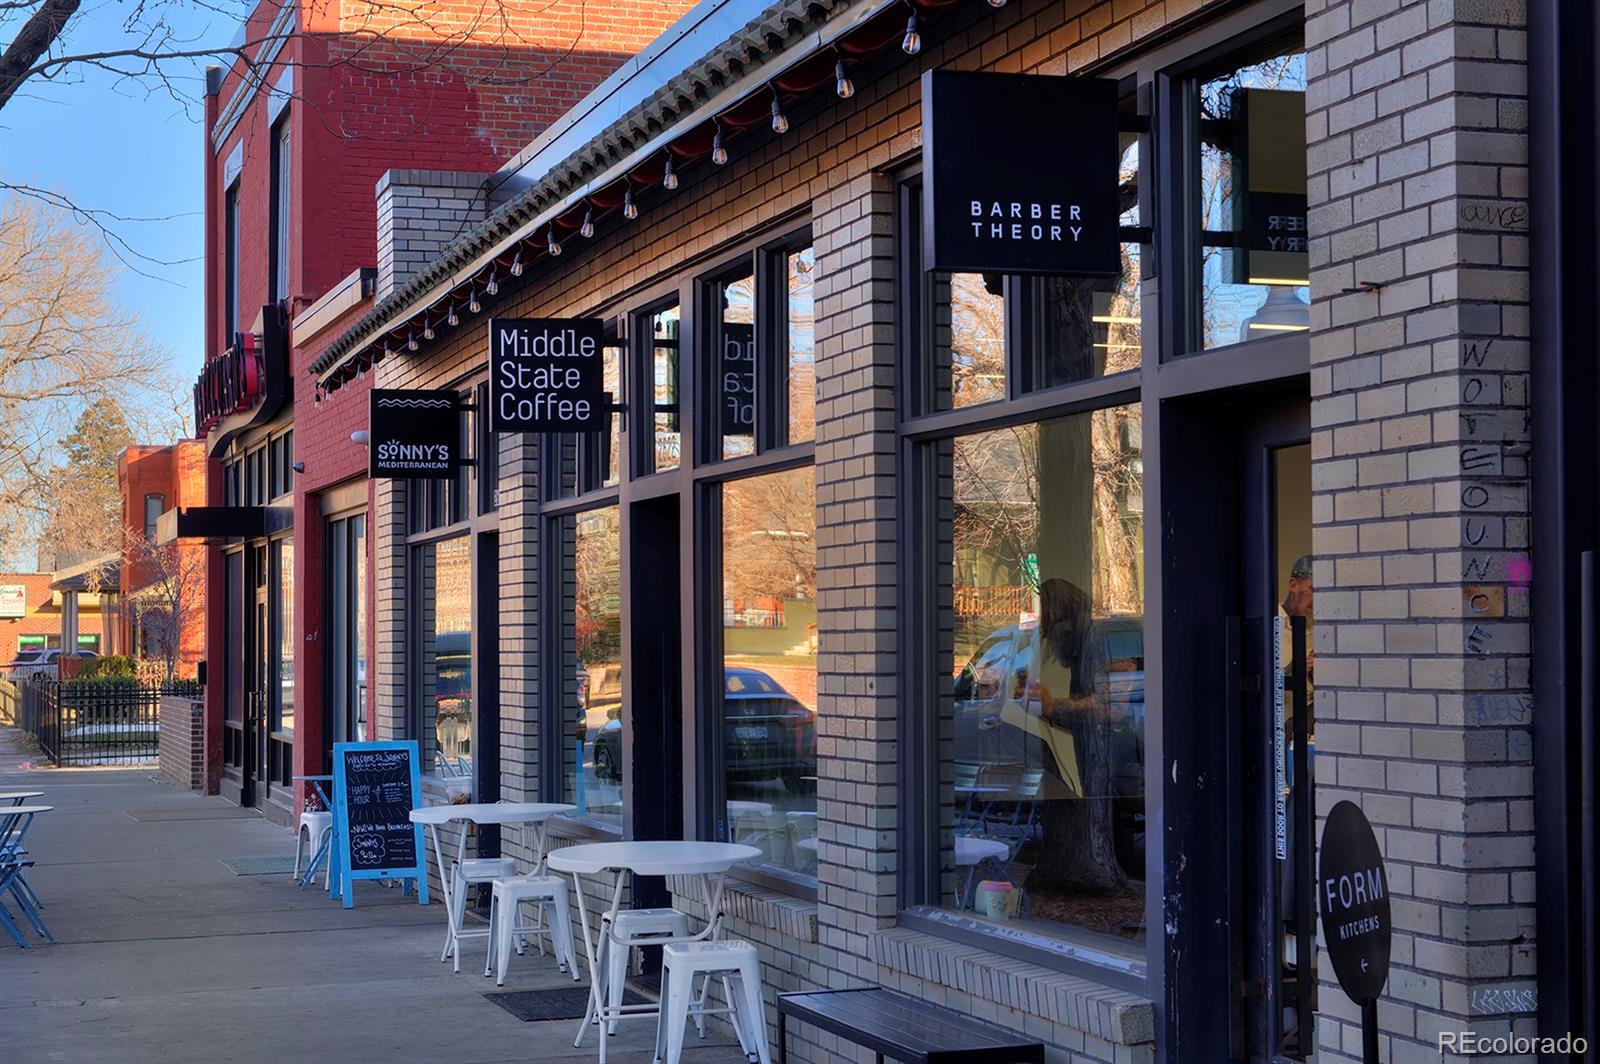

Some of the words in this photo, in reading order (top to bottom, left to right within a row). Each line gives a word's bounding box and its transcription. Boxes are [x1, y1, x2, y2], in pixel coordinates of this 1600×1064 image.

[970, 200, 1082, 221] BARBER
[970, 221, 1083, 243] THEORY
[499, 328, 596, 358] Middle
[499, 360, 581, 389] State
[499, 392, 591, 421] Coffee
[377, 440, 449, 461] SONNY'S
[377, 461, 449, 470] MEDITERRANEAN
[352, 785, 371, 796] HAPPY
[353, 795, 371, 805] HOUR
[1325, 866, 1384, 913] FORM
[1338, 914, 1381, 941] KITCHENS
